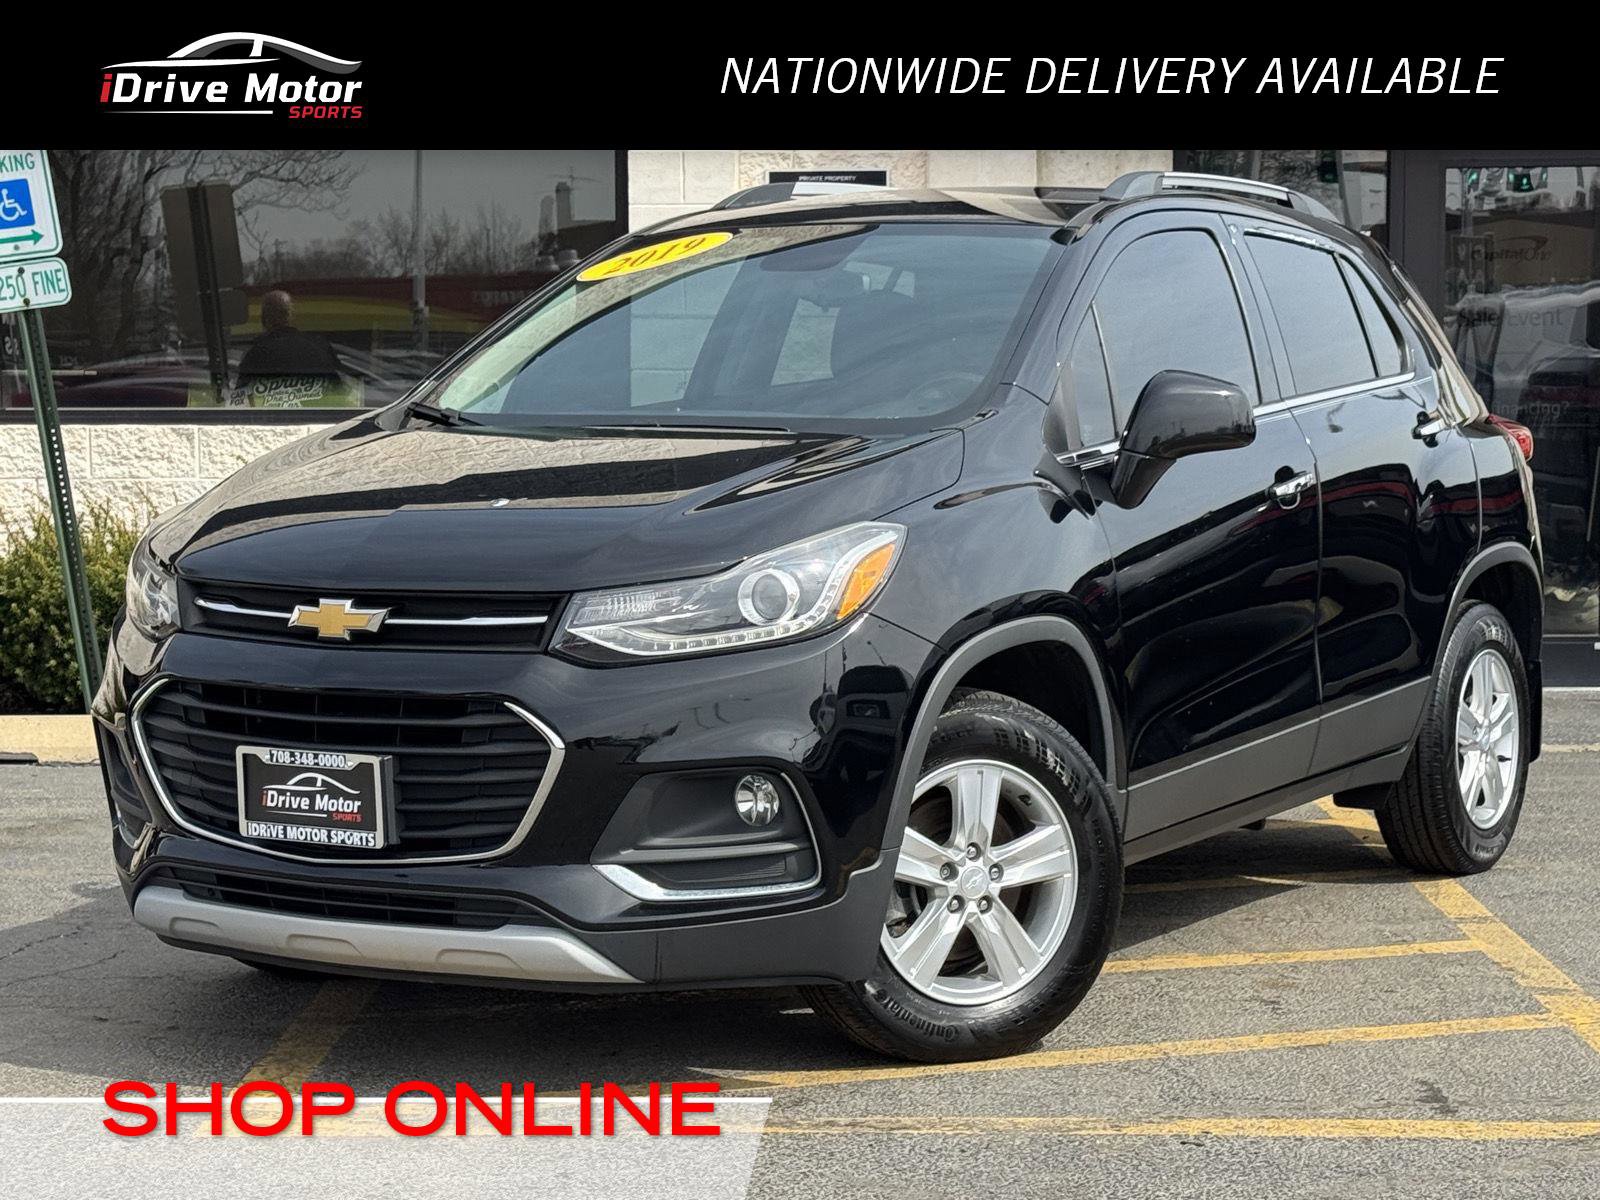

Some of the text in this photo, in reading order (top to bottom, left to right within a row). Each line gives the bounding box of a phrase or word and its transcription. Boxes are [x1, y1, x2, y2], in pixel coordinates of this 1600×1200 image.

[602, 236, 707, 276] 2019
[32, 268, 66, 297] FINE
[1507, 308, 1566, 327] Event
[230, 390, 246, 400] CAR
[271, 750, 346, 768] 708-348-0000
[262, 789, 362, 814] iDrive Motor
[332, 812, 363, 823] SPORTS
[286, 825, 329, 843] MOTOR
[330, 830, 375, 847] SPORTS
